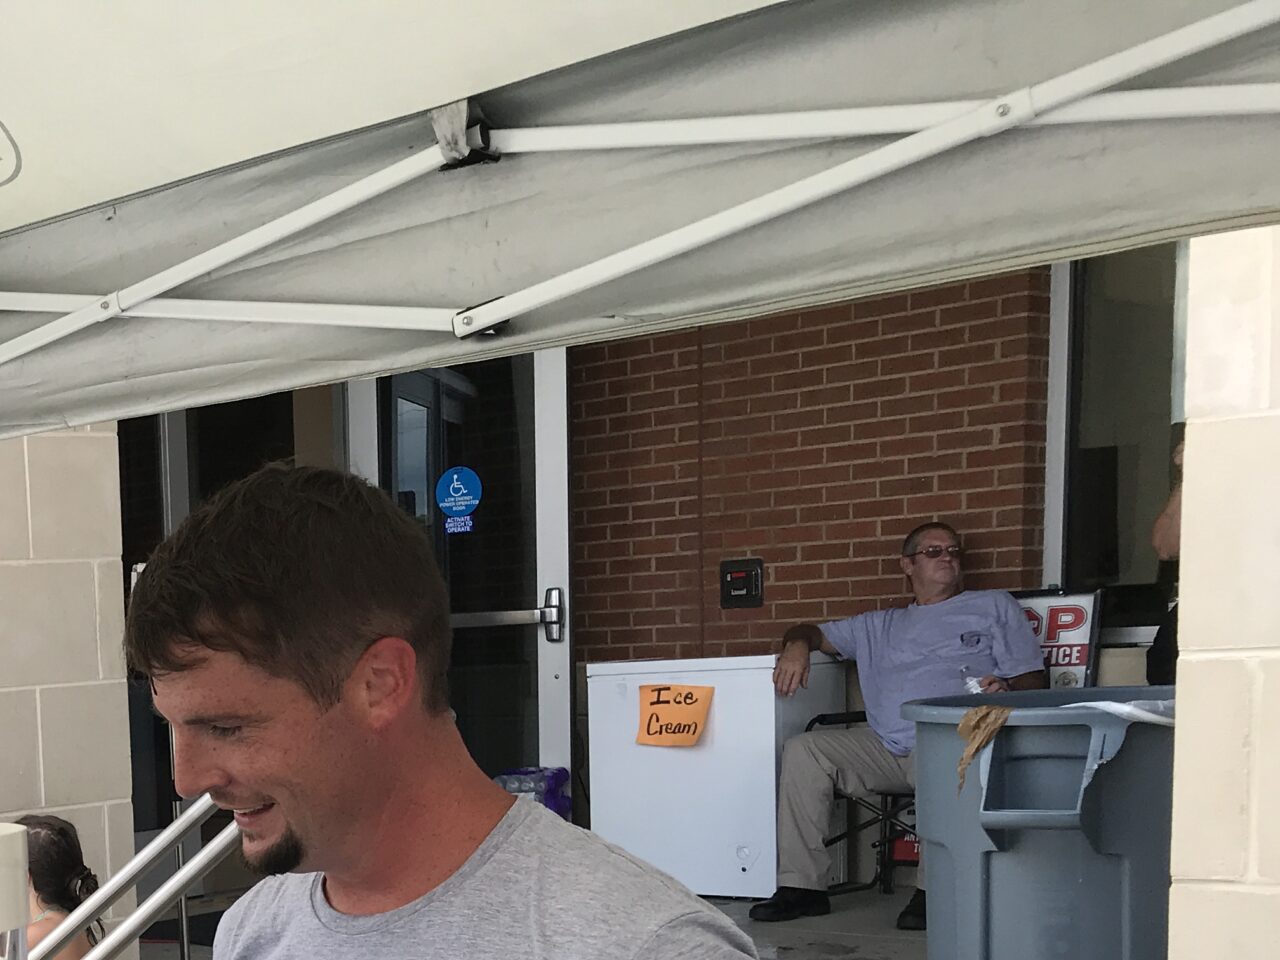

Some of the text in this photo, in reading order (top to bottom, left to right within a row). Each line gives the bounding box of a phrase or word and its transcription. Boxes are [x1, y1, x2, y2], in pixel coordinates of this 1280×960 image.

[1042, 646, 1081, 664] TICE
[650, 687, 699, 706] Ice
[647, 713, 697, 735] Cream
